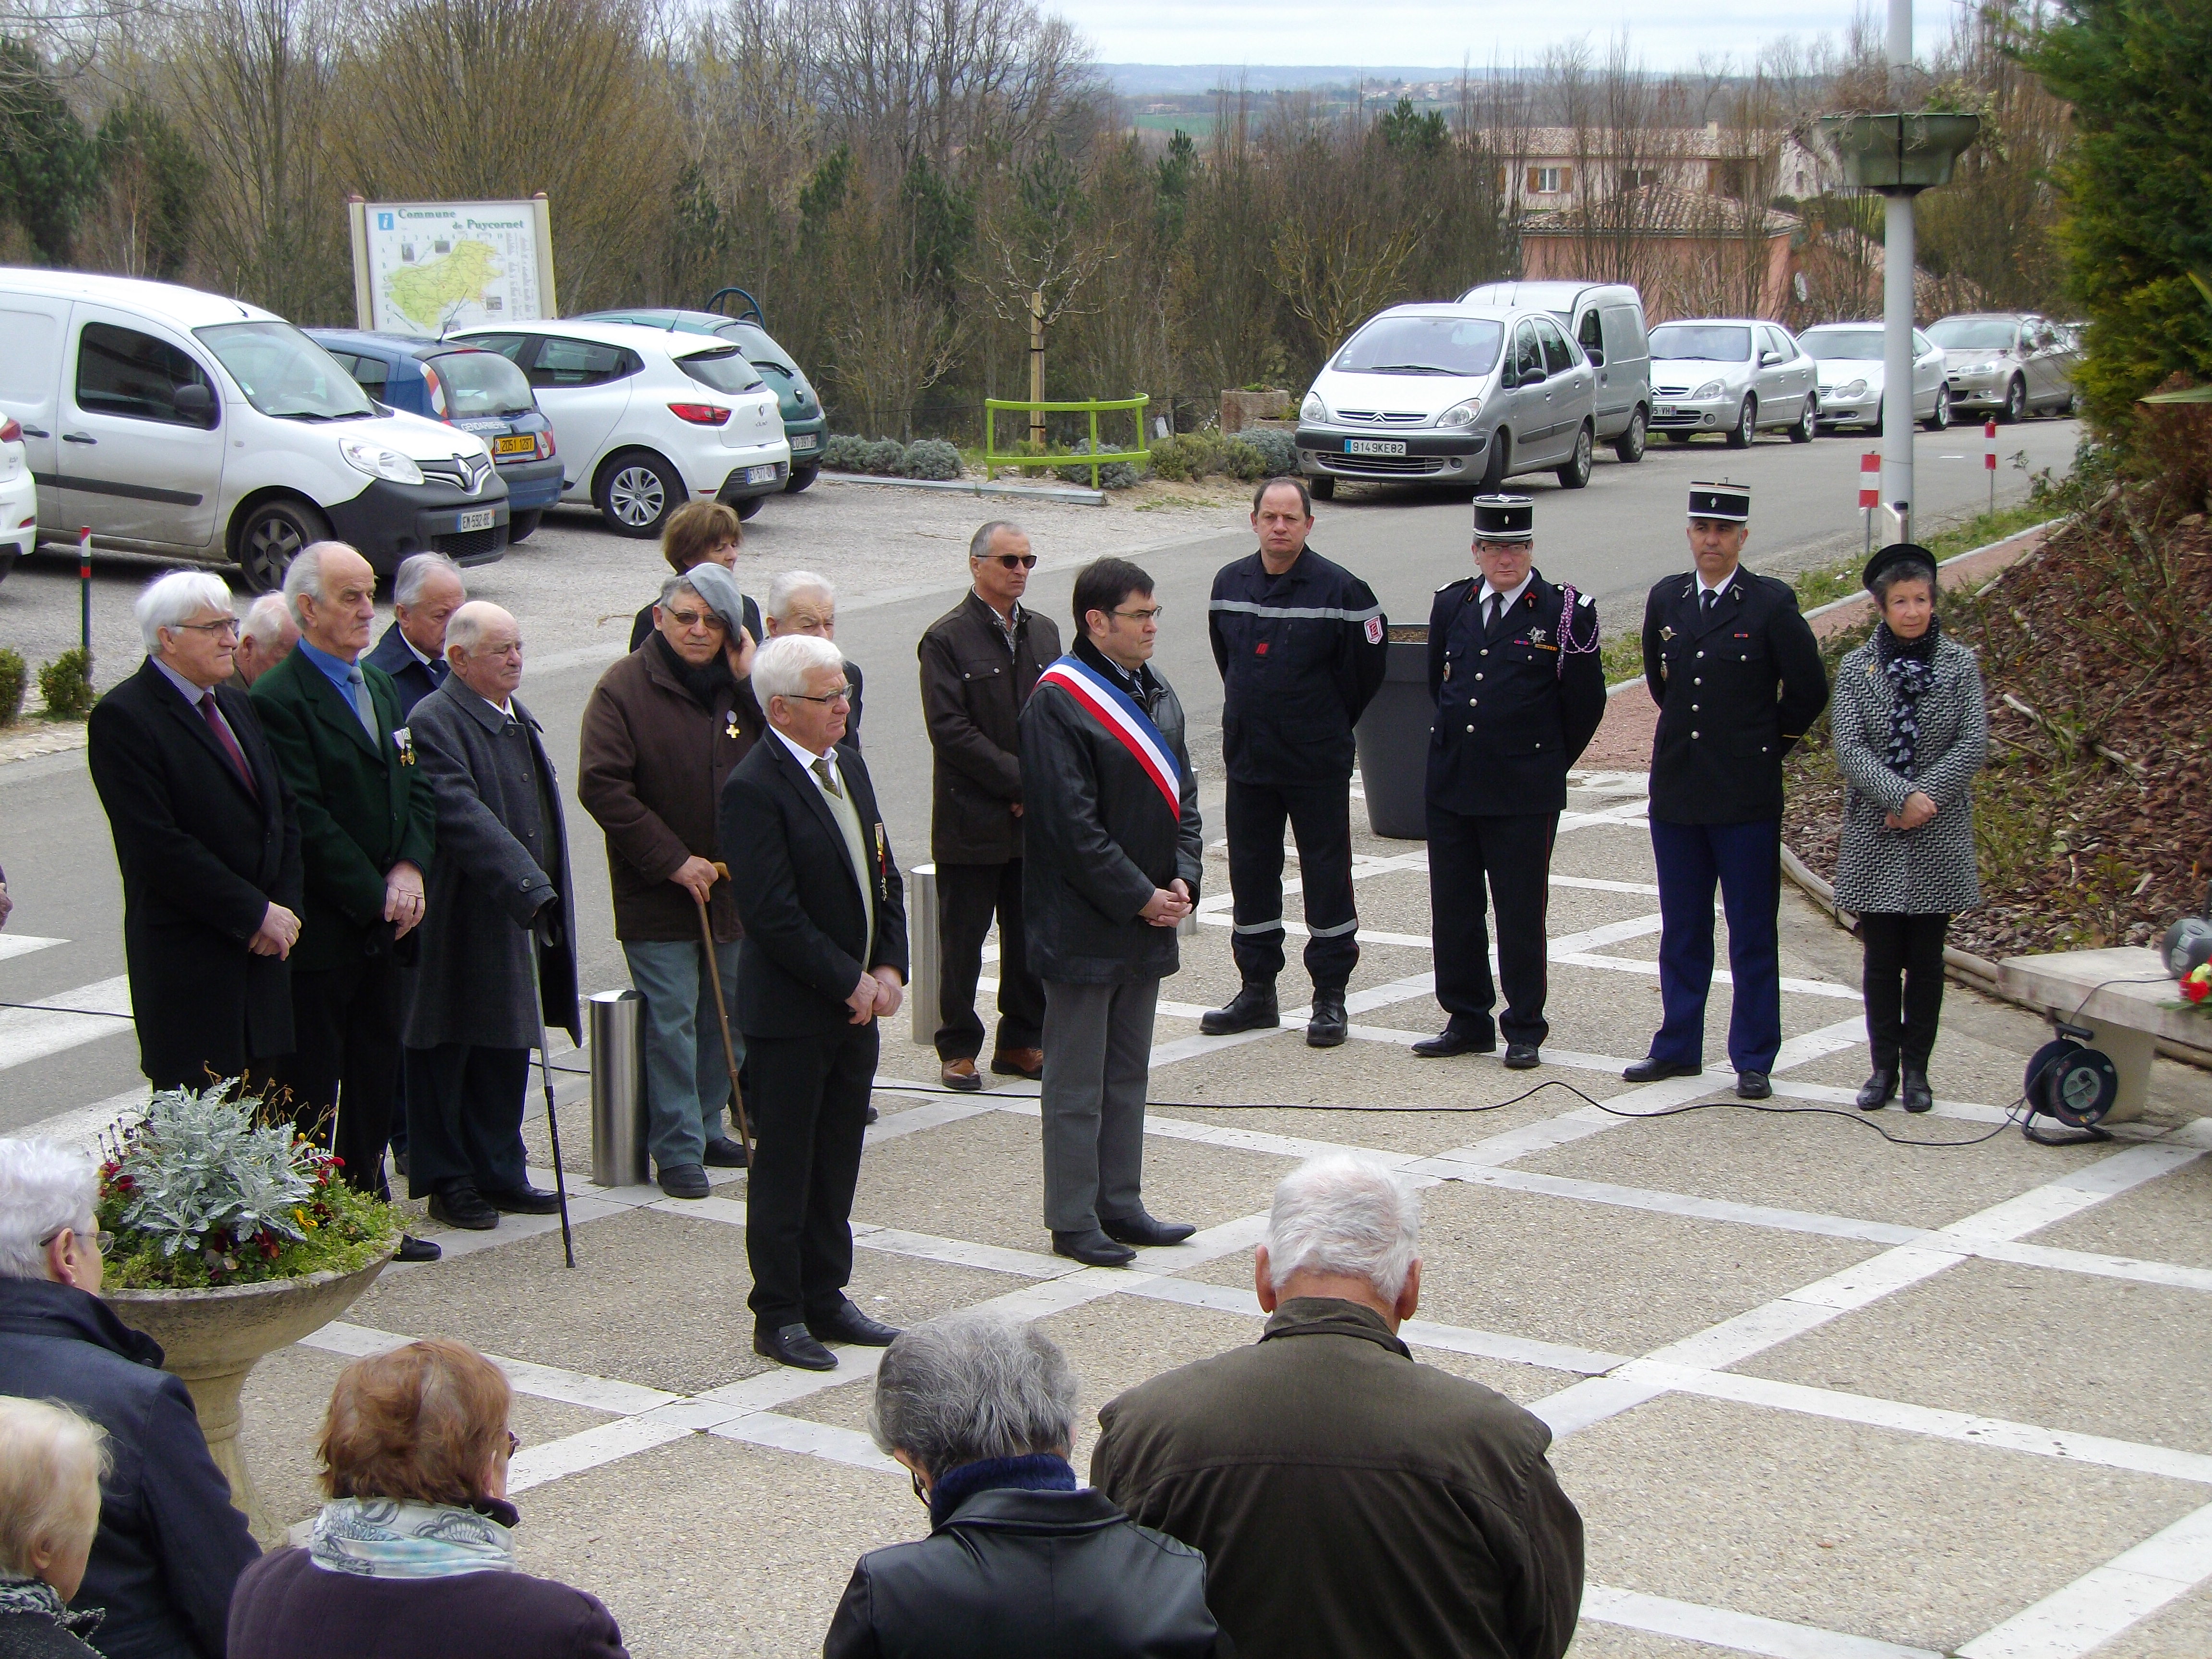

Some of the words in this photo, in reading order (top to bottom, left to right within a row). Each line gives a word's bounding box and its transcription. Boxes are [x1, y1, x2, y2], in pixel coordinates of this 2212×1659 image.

[397, 208, 456, 218] Commune
[452, 221, 463, 229] de
[467, 219, 524, 230] Puycornet
[1353, 442, 1404, 453] 9149KE82
